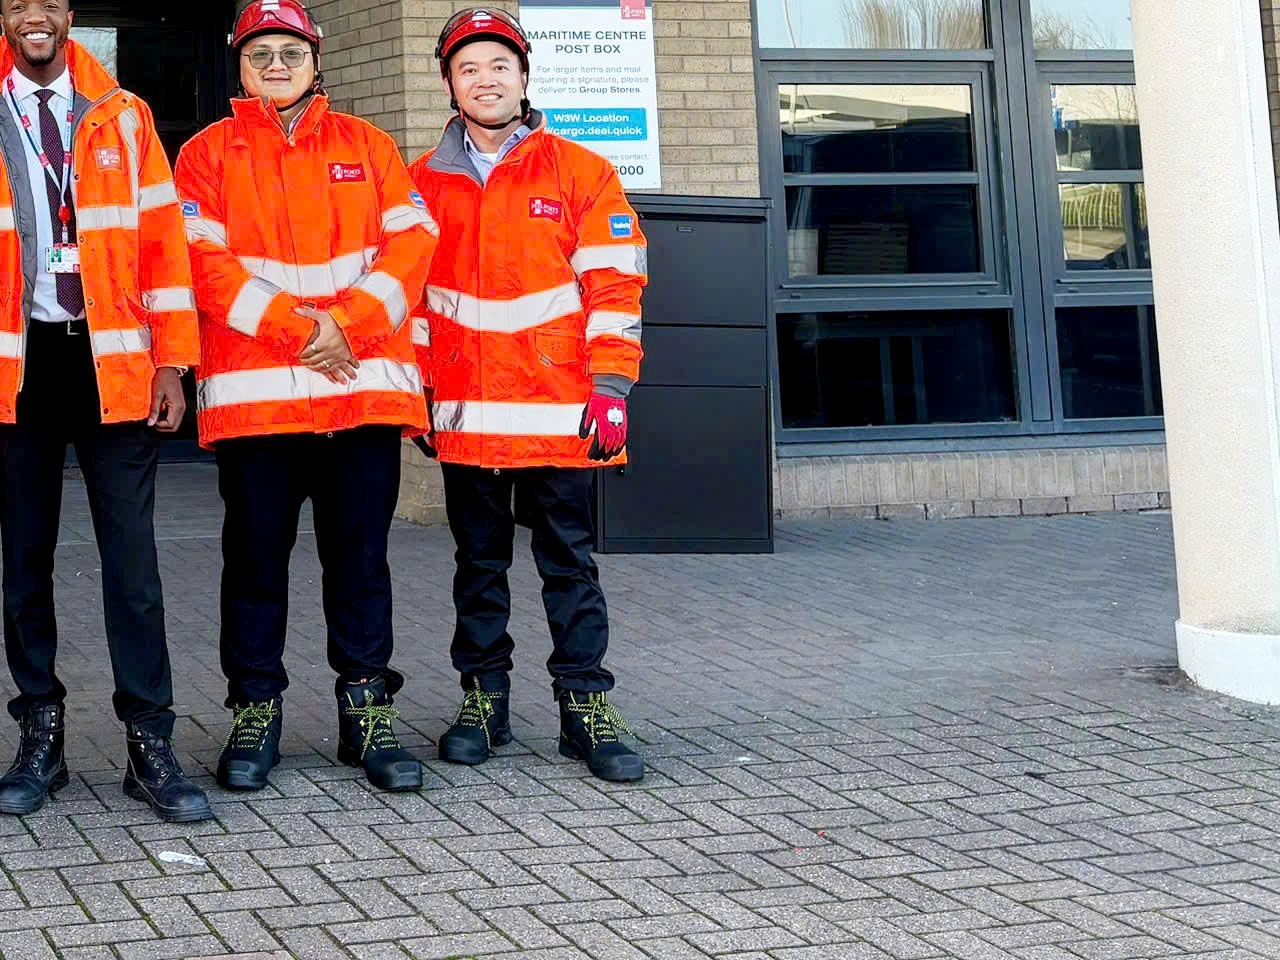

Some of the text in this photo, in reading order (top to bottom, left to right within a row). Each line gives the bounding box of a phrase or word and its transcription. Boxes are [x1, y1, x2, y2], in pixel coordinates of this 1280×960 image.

[527, 31, 647, 40] MARITIME CENTRE
[555, 44, 621, 54] POST BOX
[553, 66, 578, 75] larger
[530, 76, 568, 84] requiring
[621, 76, 649, 84] please
[579, 86, 608, 95] Group
[553, 113, 630, 123] W3W Location
